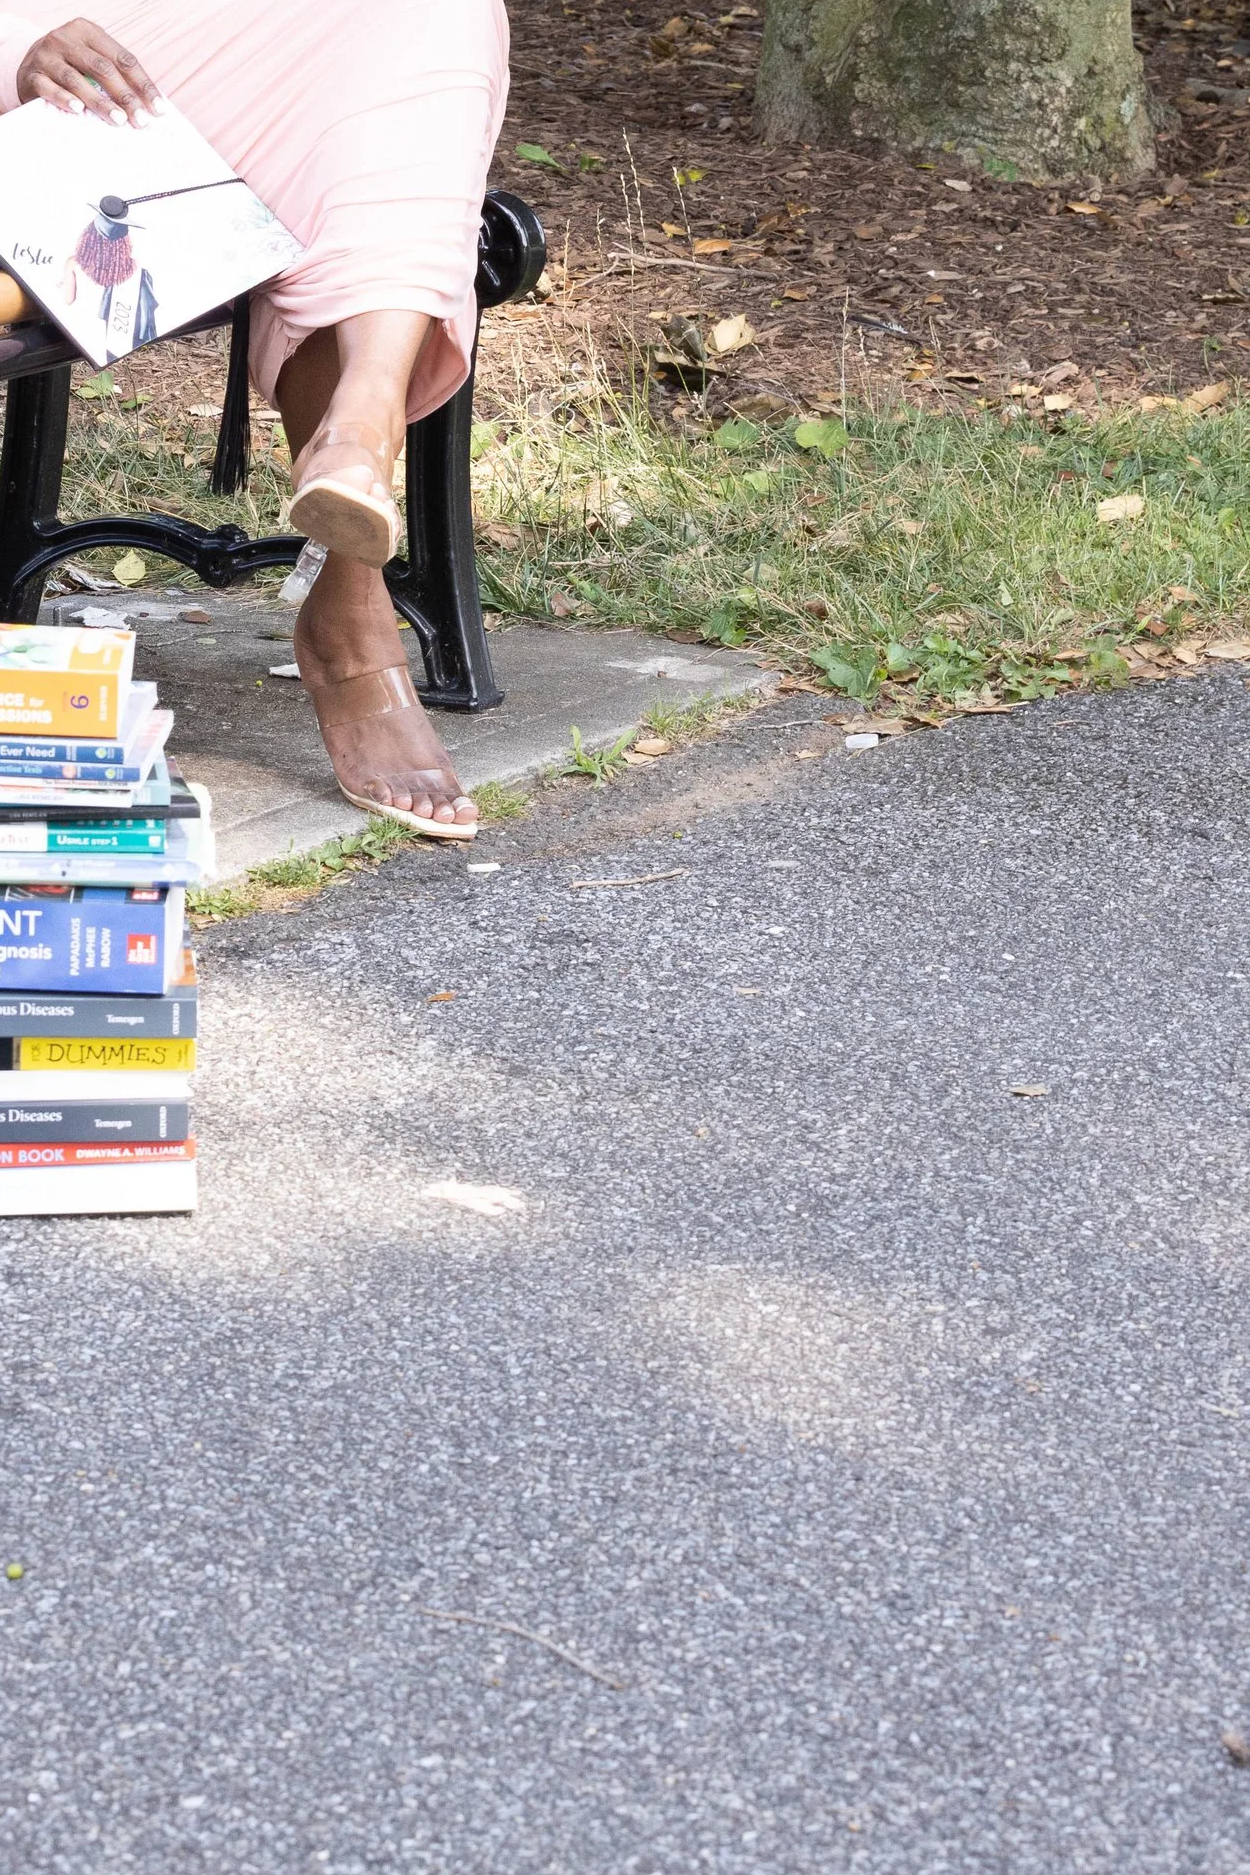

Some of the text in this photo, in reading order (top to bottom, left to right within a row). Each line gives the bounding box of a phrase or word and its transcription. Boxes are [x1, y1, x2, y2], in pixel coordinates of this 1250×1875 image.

[112, 300, 132, 335] 2023
[0, 745, 24, 757] Ever
[25, 746, 56, 758] Need
[23, 764, 44, 775] Tests
[70, 917, 81, 976] PAPADAKIS
[101, 927, 111, 968] RABOW
[19, 1002, 75, 1017] Diseases
[172, 1003, 180, 1035] OXFORD
[48, 1043, 170, 1066] DUMMIES
[8, 1109, 63, 1123] Diseases
[159, 1106, 167, 1138] OXFORD
[18, 1148, 65, 1163] BOOK
[76, 1147, 121, 1159] DWAYNE
[134, 1145, 186, 1157] WILLIAMS
